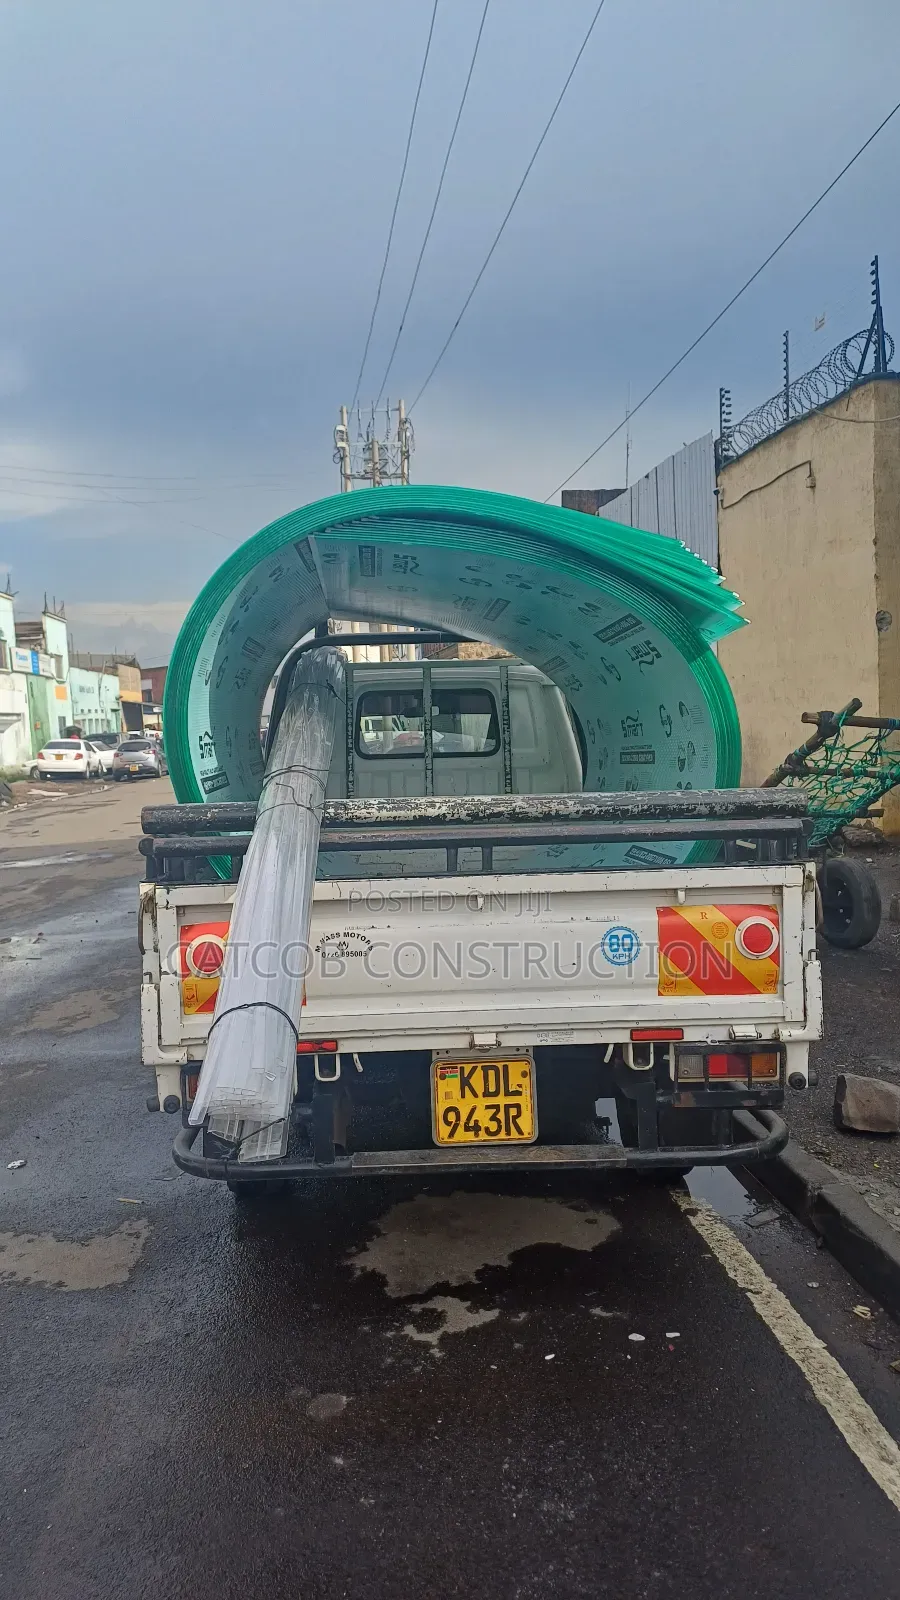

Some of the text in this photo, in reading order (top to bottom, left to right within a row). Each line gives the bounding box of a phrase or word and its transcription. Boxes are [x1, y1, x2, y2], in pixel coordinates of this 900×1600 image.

[700, 911, 708, 920] R
[608, 933, 634, 953] 80
[612, 952, 631, 961] KPH
[459, 1064, 523, 1099] KDL
[442, 1103, 525, 1139] 943R
